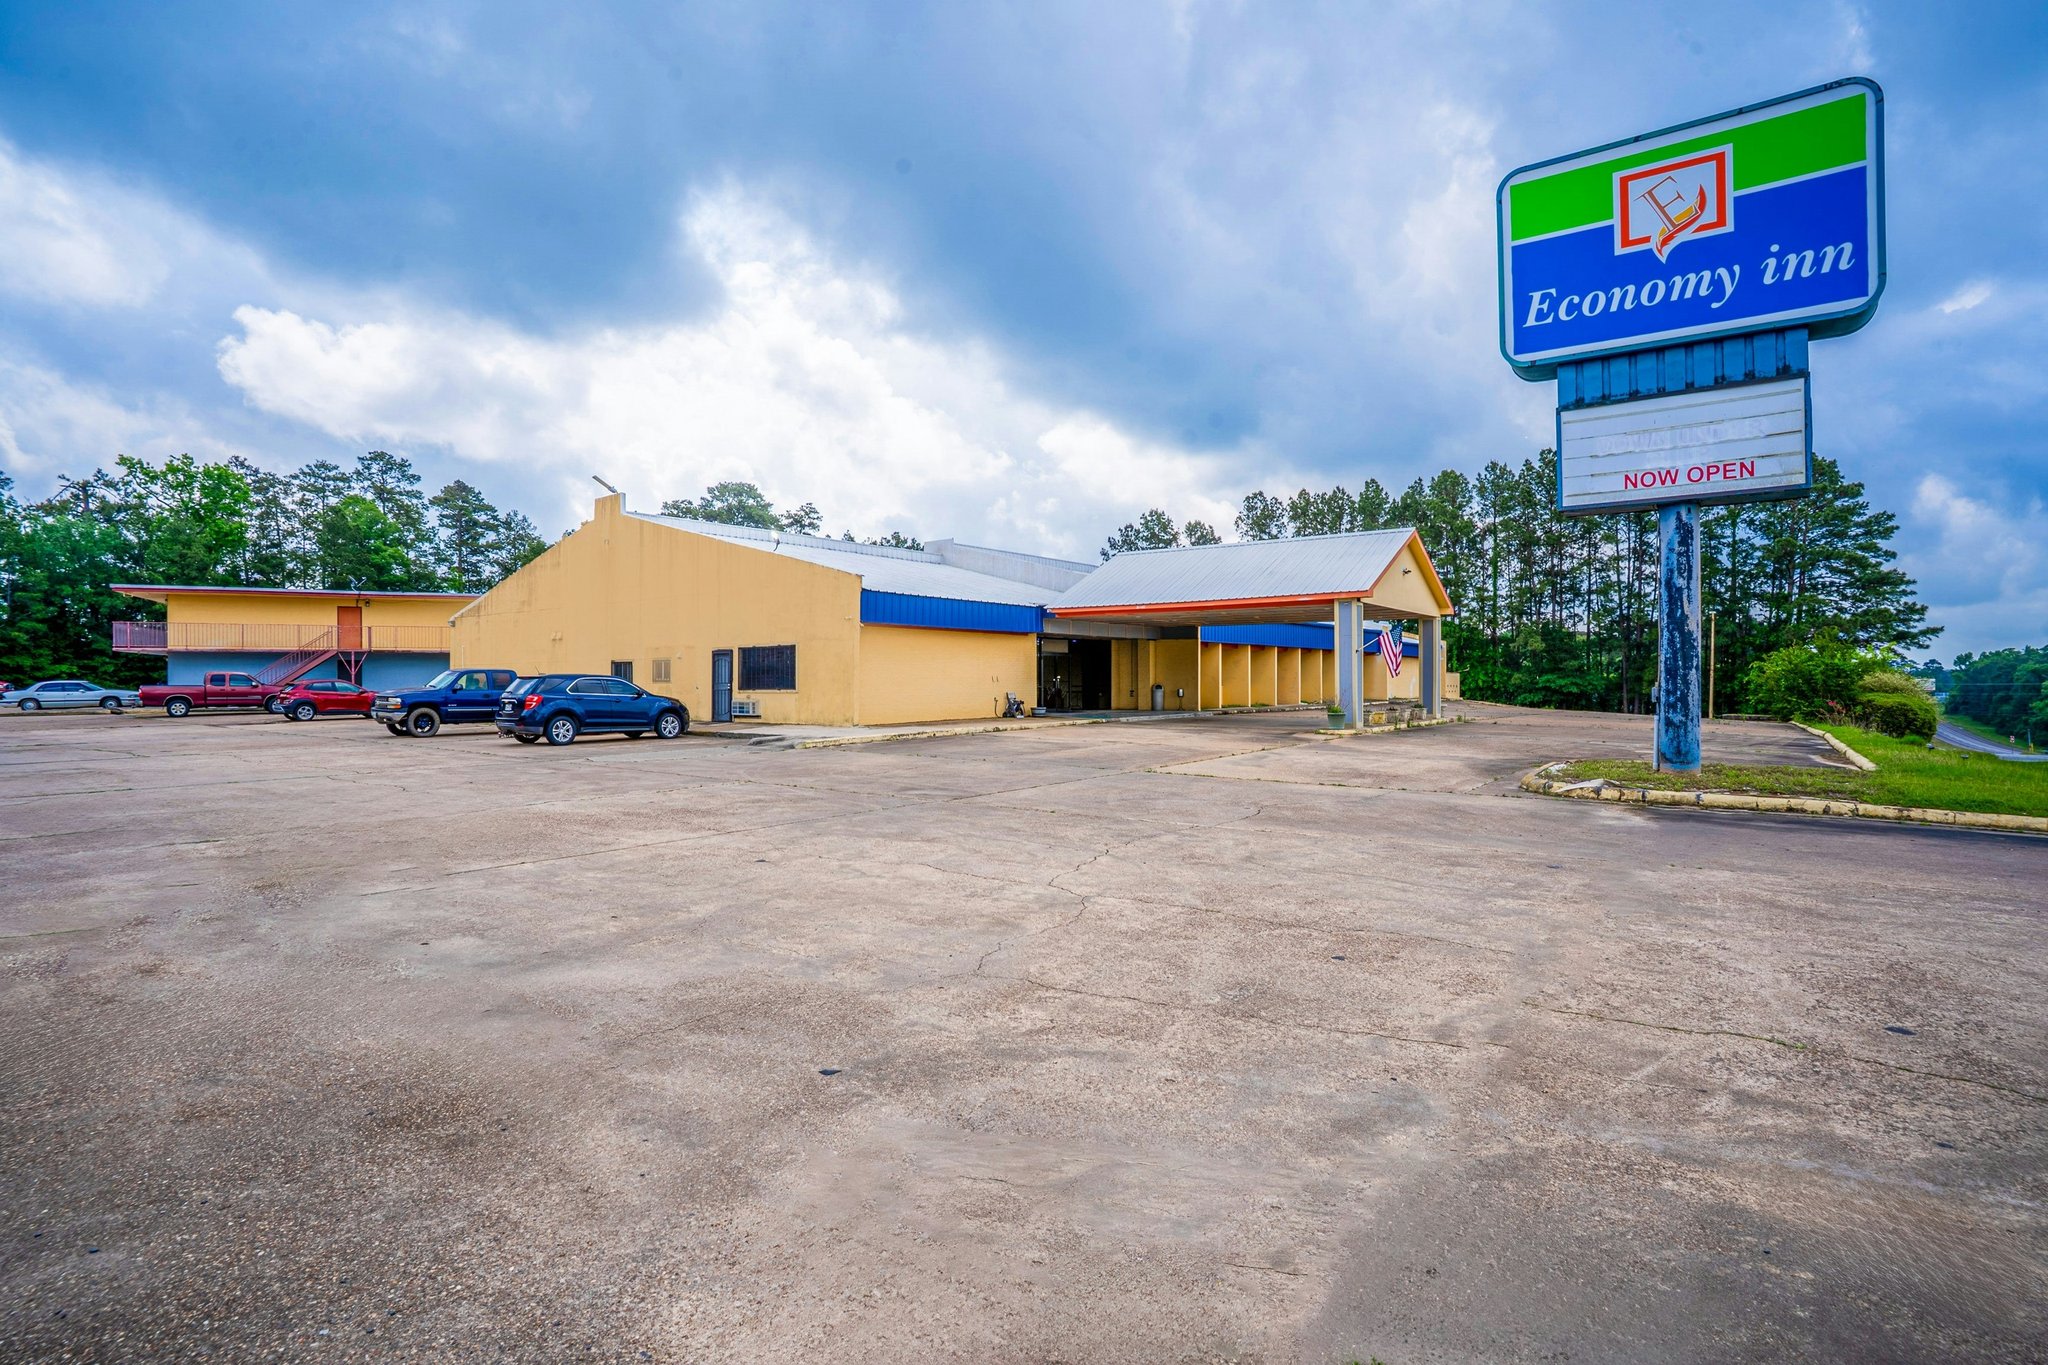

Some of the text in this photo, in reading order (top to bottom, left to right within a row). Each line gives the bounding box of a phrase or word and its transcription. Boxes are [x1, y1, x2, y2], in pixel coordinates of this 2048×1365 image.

[1522, 242, 1855, 328] Economy inn
[1623, 460, 1755, 489] NOW OPEN
